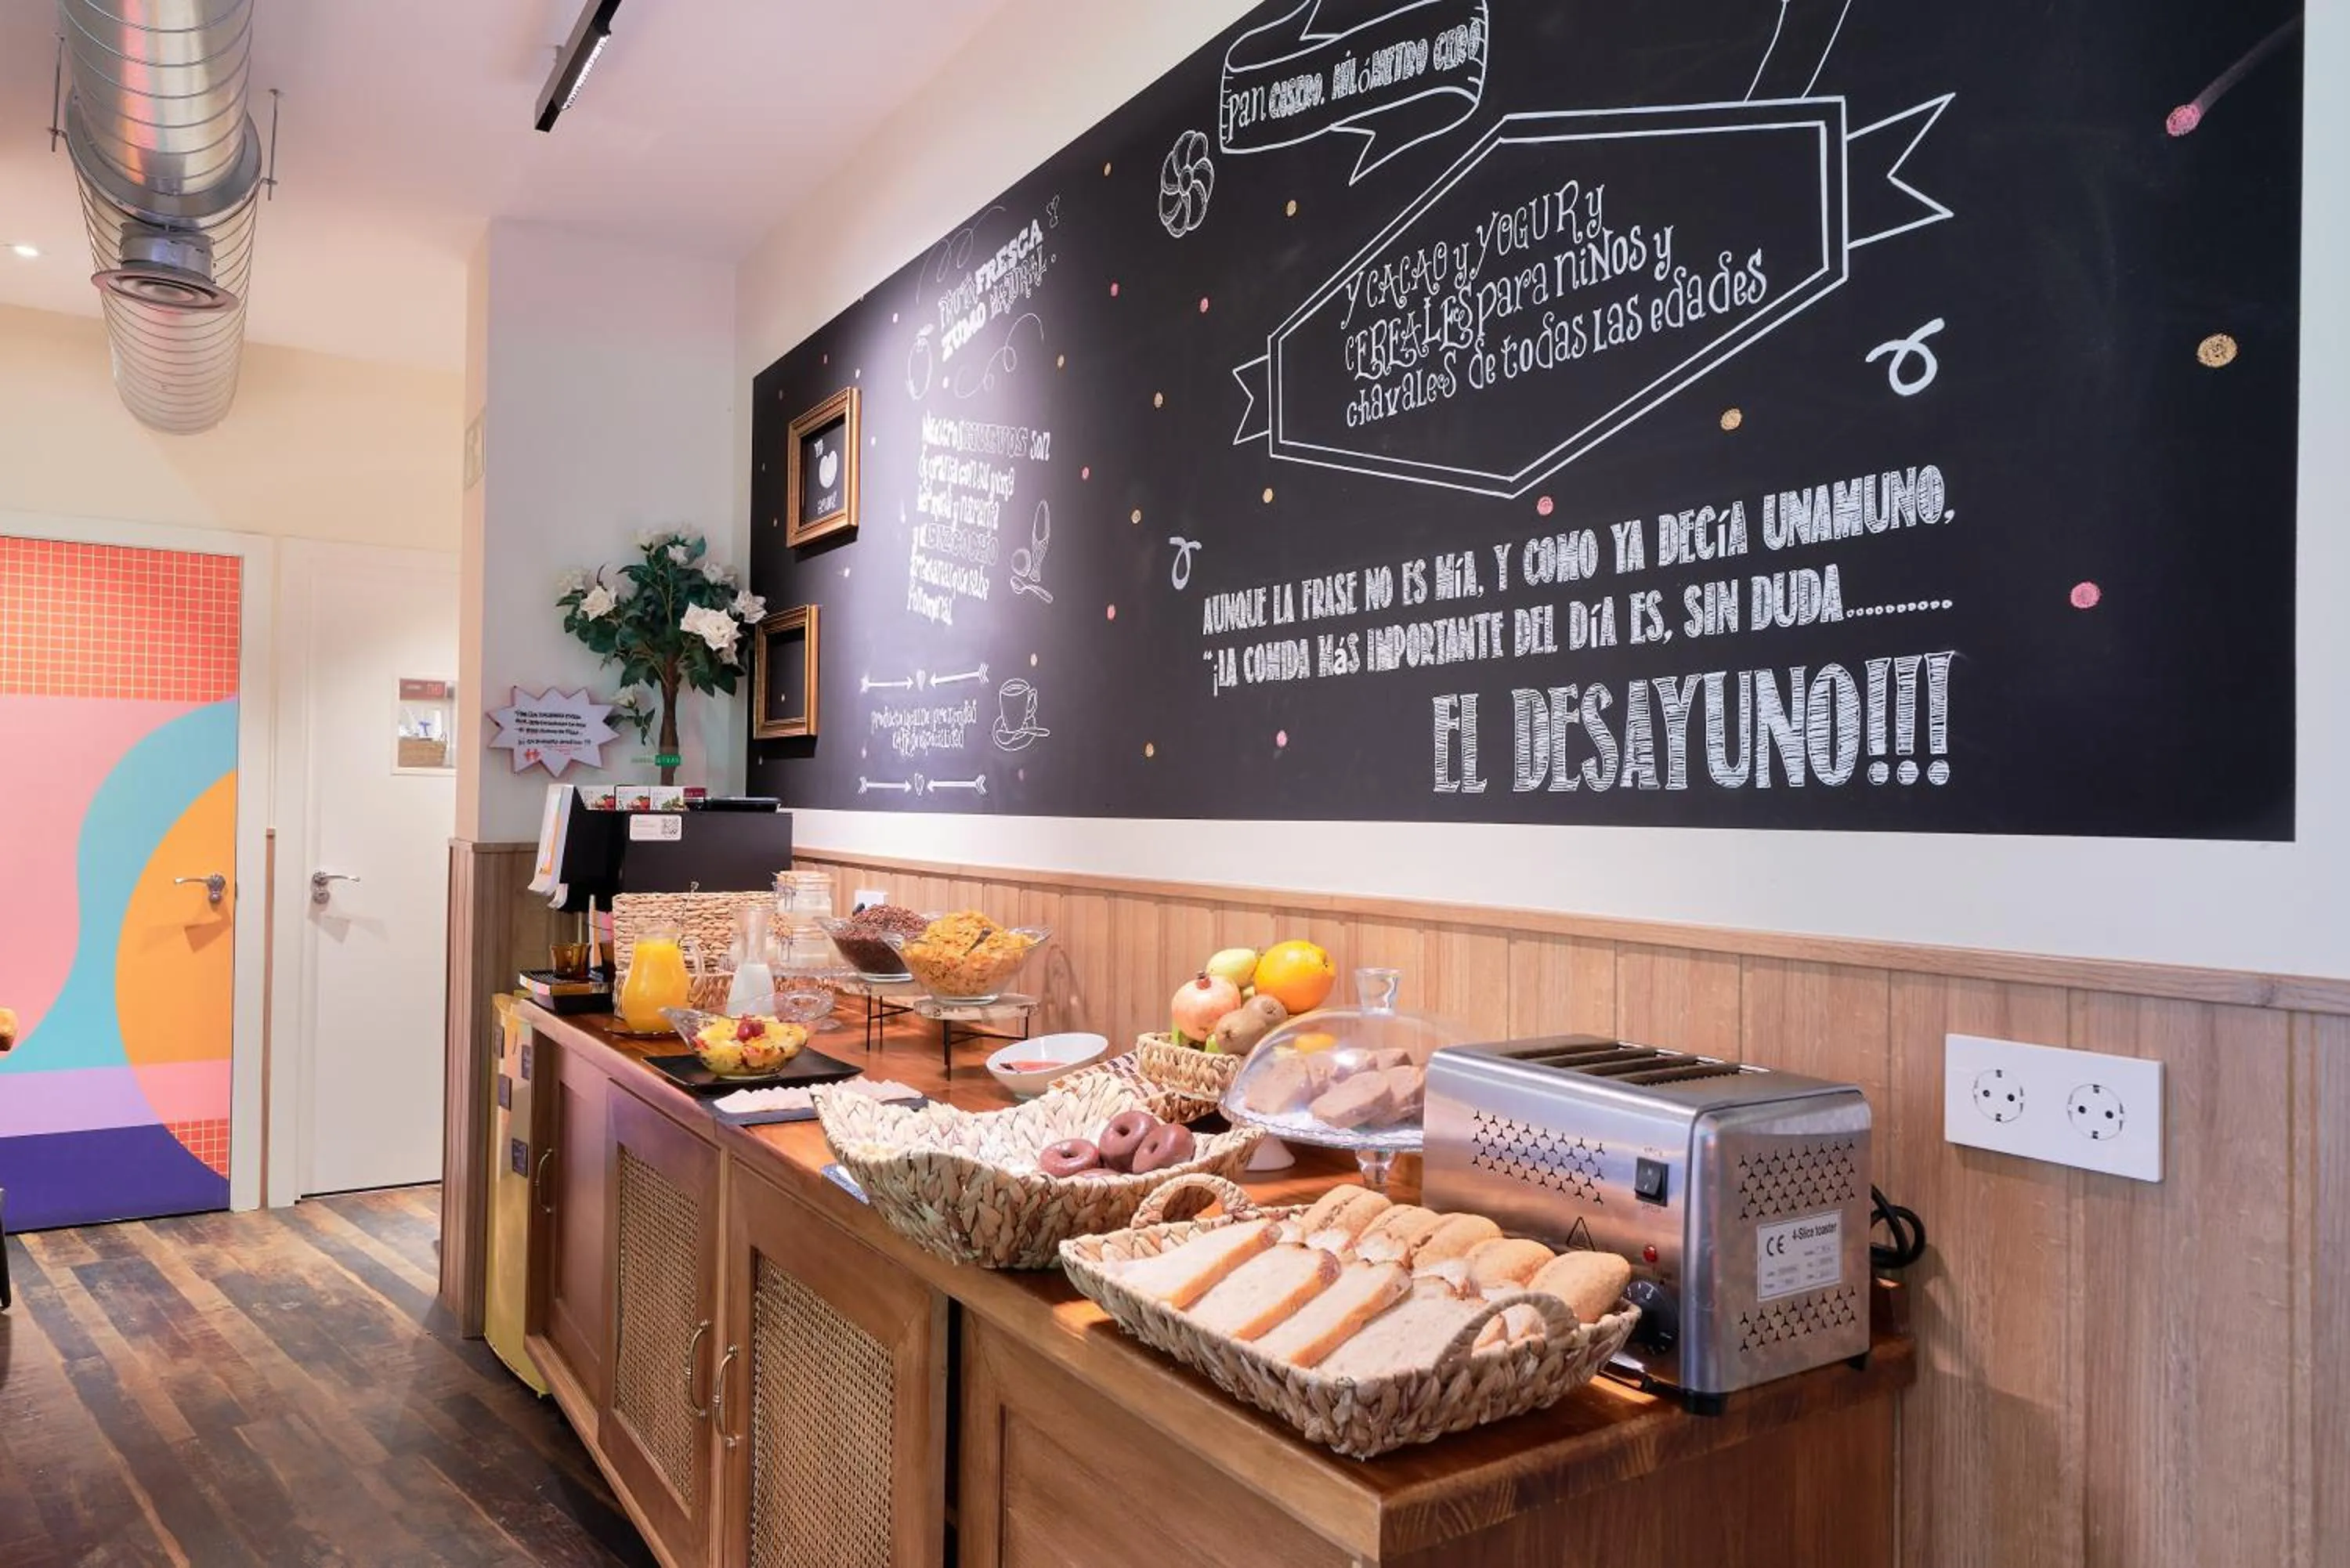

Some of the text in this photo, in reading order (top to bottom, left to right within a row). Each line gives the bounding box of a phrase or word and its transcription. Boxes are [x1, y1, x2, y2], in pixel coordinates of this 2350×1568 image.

[975, 219, 1043, 294] FRESCA
[1366, 241, 1448, 309] CACAO
[1470, 179, 1583, 280] YOGUR
[1202, 587, 1268, 636] AUNQUE
[1273, 583, 1296, 626] LA
[1301, 571, 1358, 622] FRASE
[1365, 565, 1394, 612] NO
[1401, 558, 1428, 606] ES
[1492, 543, 1513, 592] Y
[1522, 529, 1599, 587] COMO
[1610, 519, 1646, 575] YA
[1762, 464, 1956, 551] UNAMUNO,
[1242, 638, 1311, 685] COMIDA
[1366, 610, 1505, 673] IMPORTANTE
[1513, 604, 1558, 659] DEL
[1629, 589, 1673, 645] ES,
[1683, 578, 1739, 639] SIN
[1432, 650, 1956, 793] EL DESAYUNO!!!
